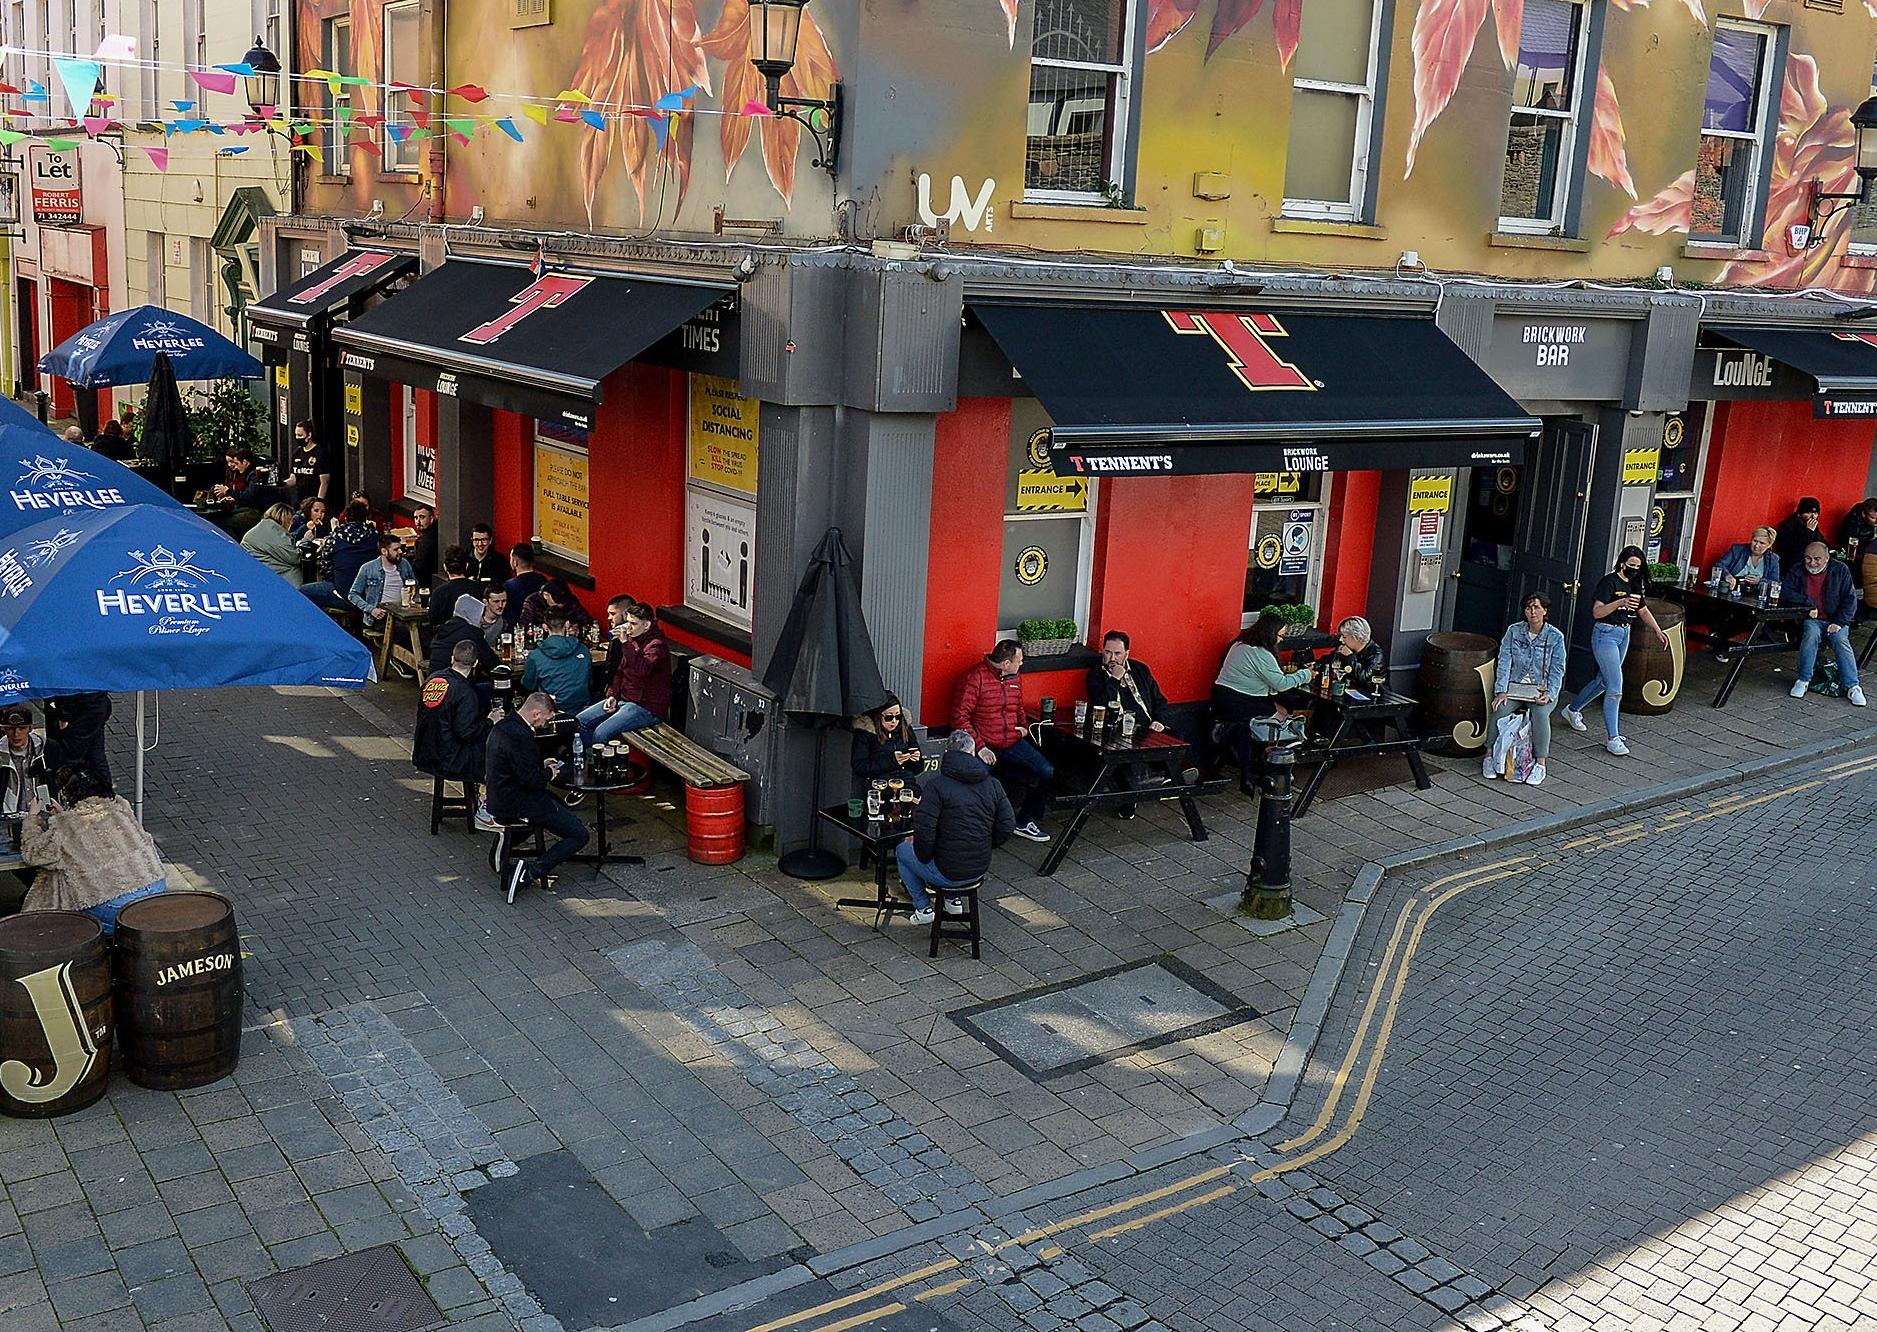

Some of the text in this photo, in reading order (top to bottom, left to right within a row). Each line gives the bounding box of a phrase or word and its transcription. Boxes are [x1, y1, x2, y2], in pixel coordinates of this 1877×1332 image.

[45, 152, 63, 163] To
[37, 162, 72, 178] Let
[35, 198, 79, 208] FERRIS
[918, 173, 996, 232] UV
[287, 251, 397, 304] T
[457, 271, 597, 346] T
[681, 324, 720, 353] TIMES
[1522, 326, 1586, 343] BRICKWORK
[132, 337, 205, 351] HEVERLEE
[1160, 309, 1319, 391] T
[1536, 344, 1570, 366] BAR
[436, 379, 459, 397] LOUNGE
[711, 403, 742, 421] SOCIAL
[1824, 400, 1832, 415] T
[702, 420, 753, 441] DISTANCING
[707, 444, 747, 461] SLOW THE SPREAD
[1283, 447, 1318, 456] BRICKWORK
[711, 454, 722, 463] KILL
[722, 457, 731, 466] THE
[711, 463, 724, 472] STOP
[1070, 456, 1084, 472] T
[1086, 455, 1173, 471] TENNENT'S
[1284, 455, 1329, 471] LOUNGE
[1625, 461, 1656, 471] ENTRANCE
[564, 466, 572, 477] DO
[572, 470, 583, 481] NOT
[543, 488, 555, 500] FULL
[555, 491, 571, 505] TABLE
[1020, 484, 1064, 495] ENTRANCE
[1412, 490, 1448, 499] ENTRANCE
[9, 487, 126, 511] HEVERLEE
[551, 502, 583, 520] IS AVAILABLE
[96, 588, 252, 620] HEVERLEE
[159, 616, 200, 626] Premium
[148, 623, 211, 637] Pilsner Lager
[1642, 620, 1687, 707] J
[423, 682, 450, 692] SANTA
[423, 691, 444, 702] CRUZ
[924, 759, 939, 772] 79
[156, 953, 234, 987] JAMESON
[0, 960, 98, 1103] J
[95, 1025, 107, 1039] TM
